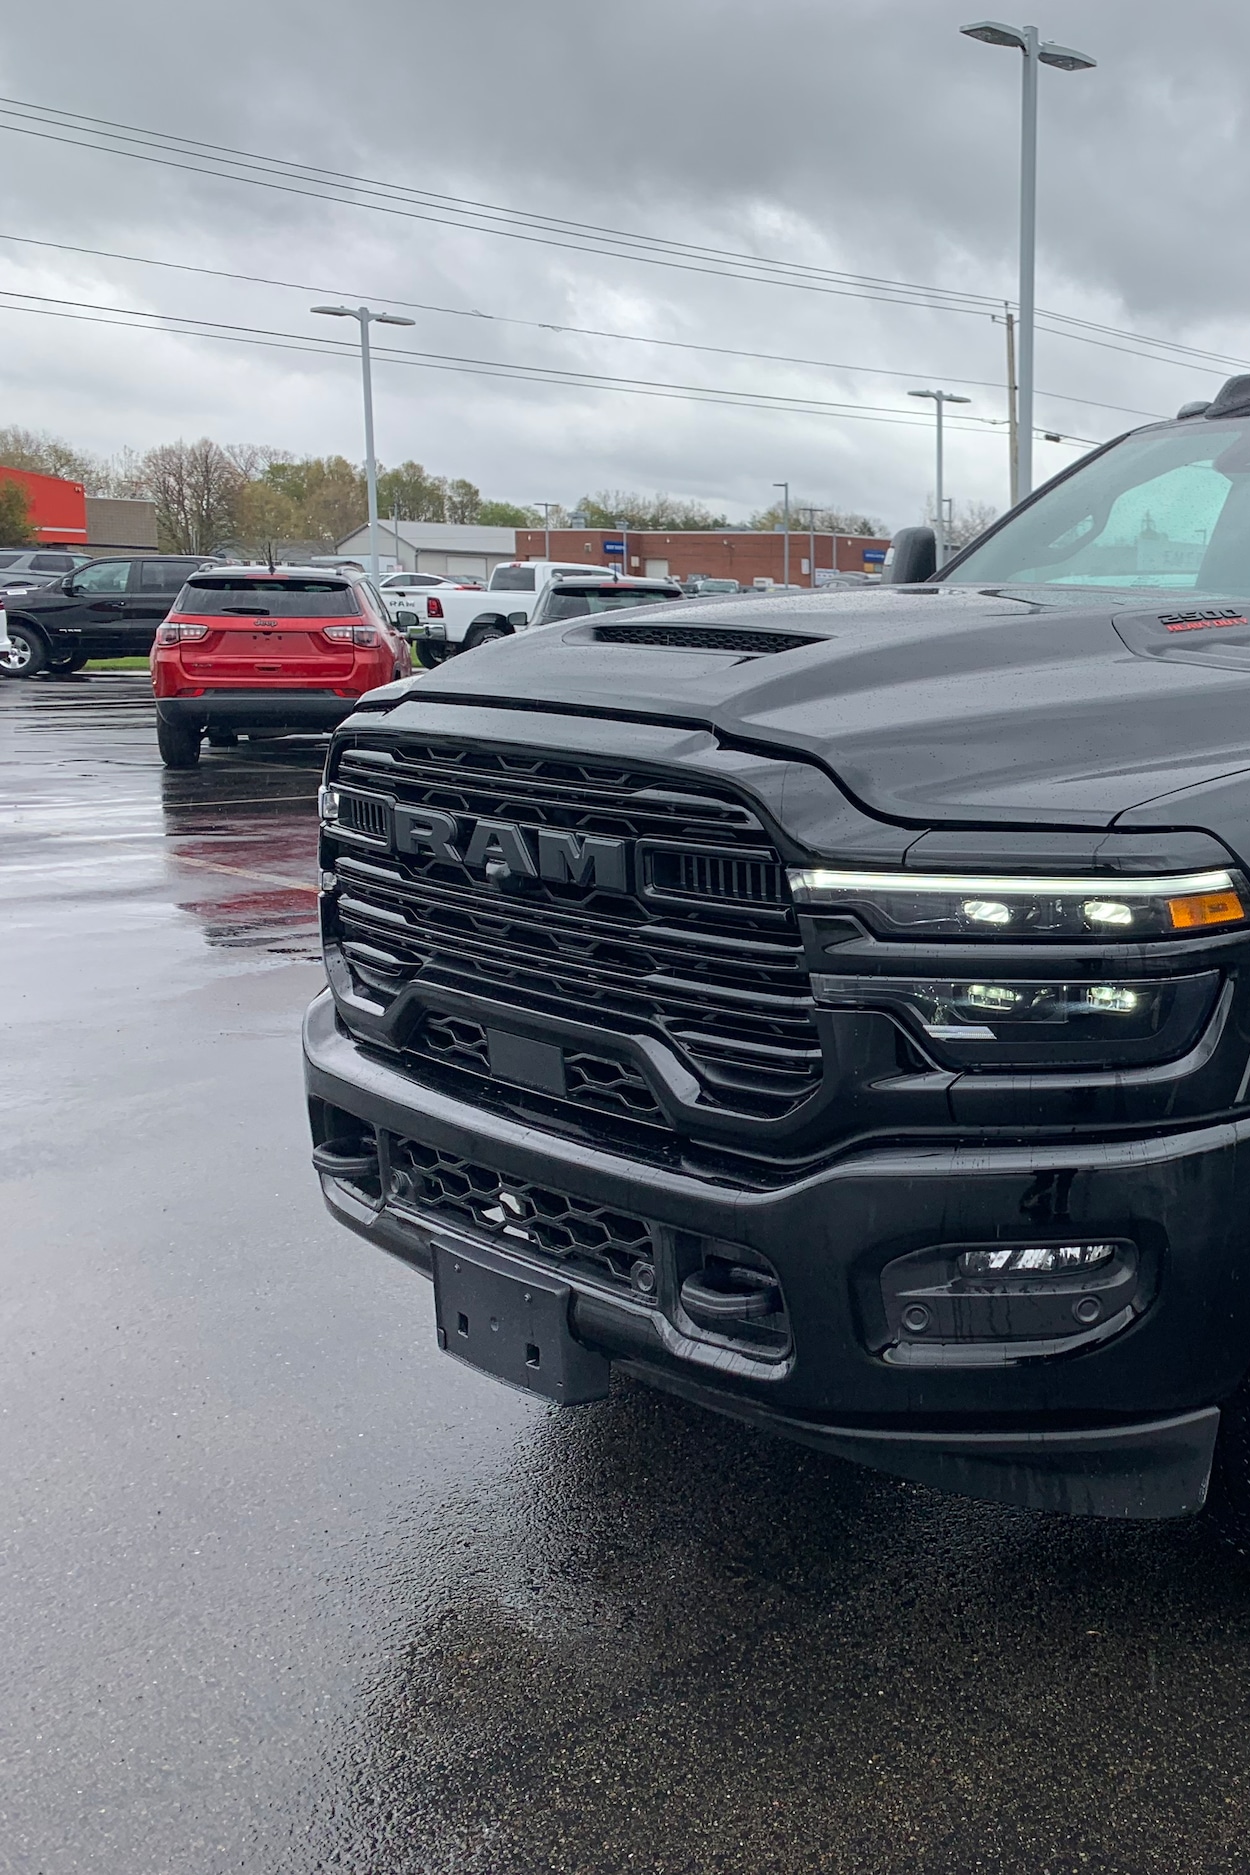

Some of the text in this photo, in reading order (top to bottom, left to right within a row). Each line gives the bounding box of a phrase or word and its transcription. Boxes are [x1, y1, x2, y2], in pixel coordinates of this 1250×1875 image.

[253, 618, 279, 628] Jeep
[1158, 609, 1243, 625] 2500
[1166, 617, 1248, 633] HEAVY DUTY
[394, 802, 629, 894] RAM
